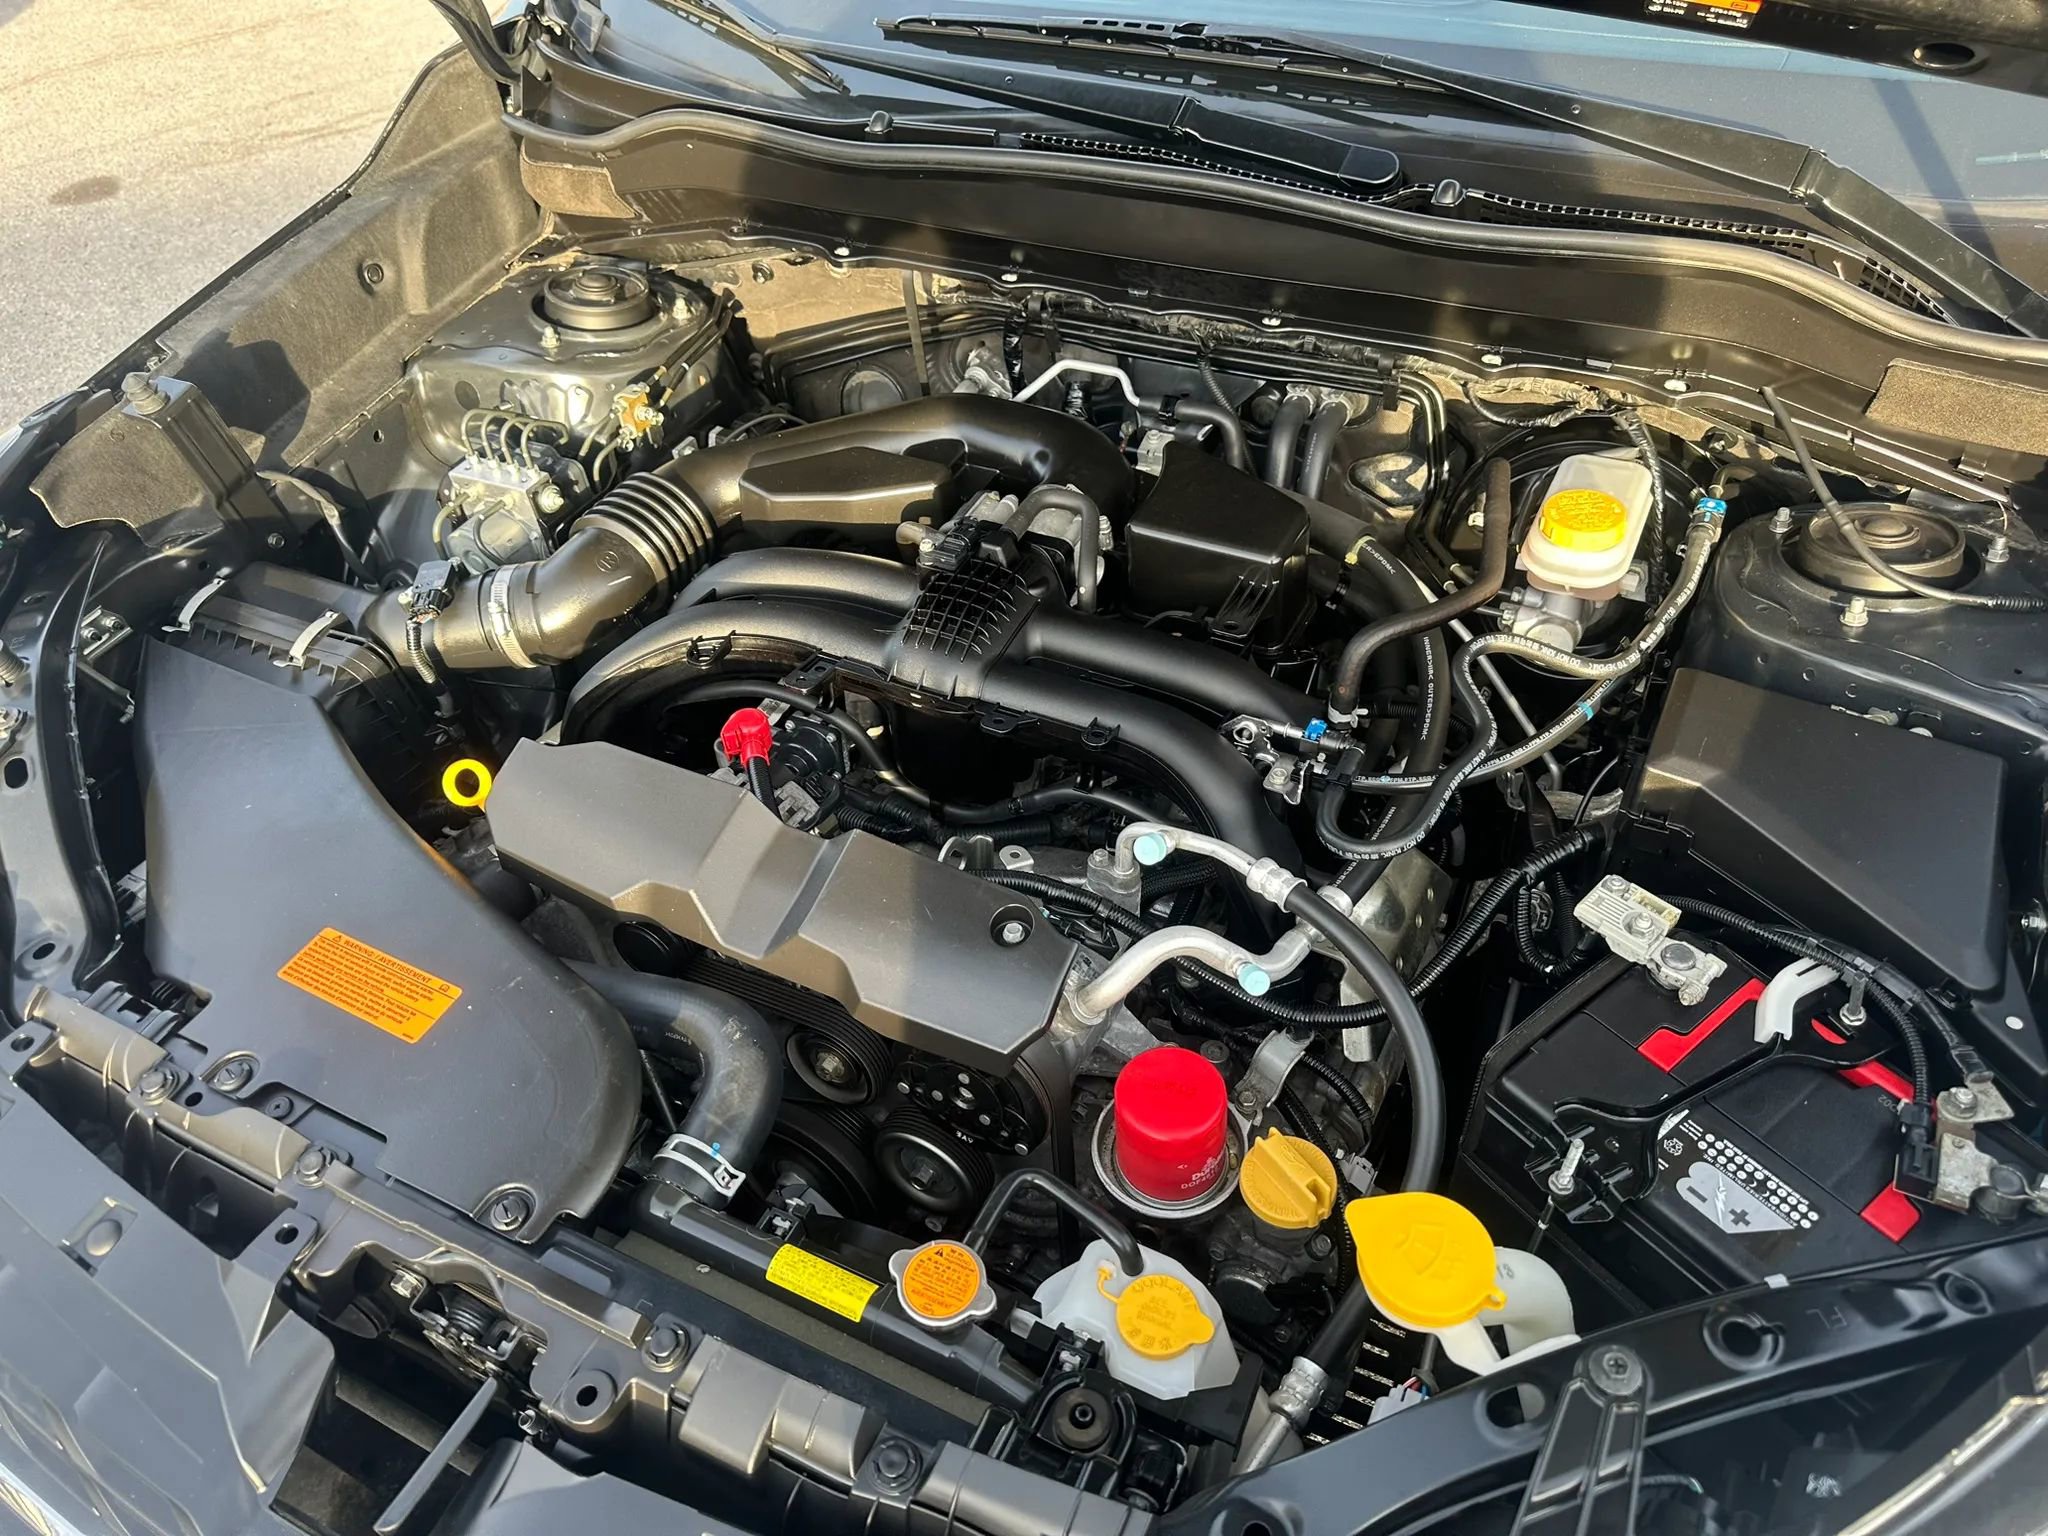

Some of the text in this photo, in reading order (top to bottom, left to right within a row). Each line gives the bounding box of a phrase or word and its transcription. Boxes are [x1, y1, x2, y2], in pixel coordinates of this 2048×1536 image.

[1403, 840, 1417, 852] NOT
[379, 955, 432, 984] AVERTISSEMENT
[1744, 1185, 1777, 1212] BATTERIES
[1775, 1208, 1799, 1228] ACTION
